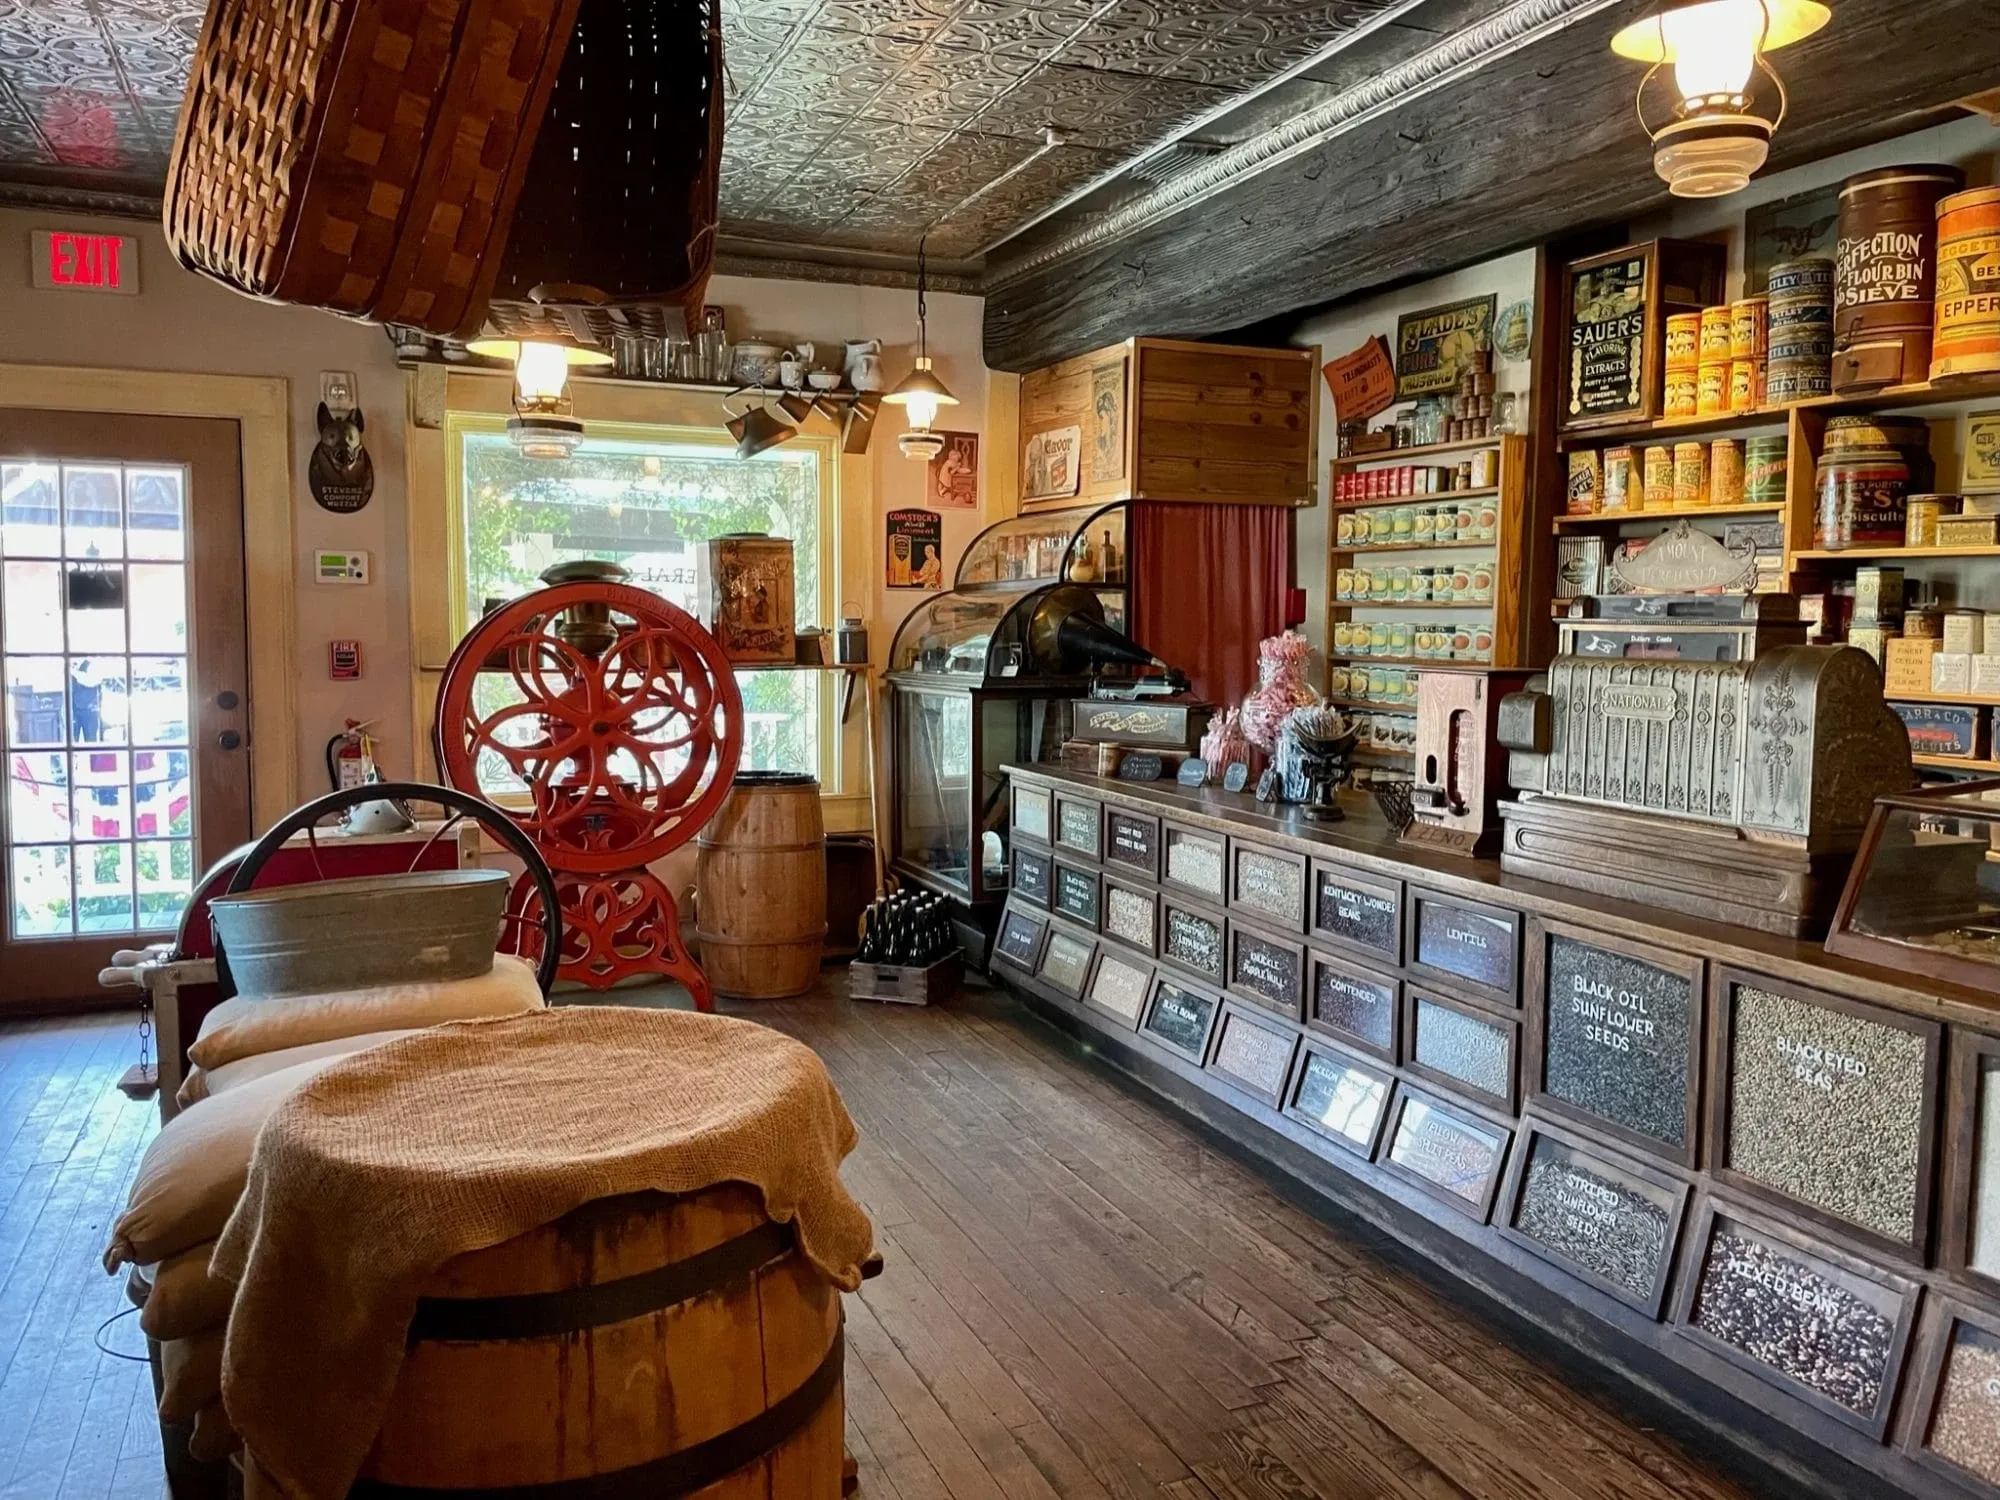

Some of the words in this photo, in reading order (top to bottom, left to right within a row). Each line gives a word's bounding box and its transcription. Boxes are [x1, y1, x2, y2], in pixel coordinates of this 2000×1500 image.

[50, 231, 123, 288] EXIT
[1837, 232, 1923, 283] ERFECTION
[1847, 260, 1894, 288] FLOUR
[1896, 258, 1925, 281] BIN
[1846, 281, 1919, 306] SIEVE
[1944, 297, 2000, 318] EPPER
[1572, 315, 1643, 346] SAUER'S
[1401, 352, 1438, 373] PURE
[1584, 342, 1628, 362] FLAVORING
[1585, 359, 1627, 377] EXTRACTS
[1584, 378, 1602, 388] PURITY
[1570, 479, 1594, 499] OATS
[889, 512, 938, 523] COMSTOCK'S
[896, 526, 935, 535] Liniment
[333, 640, 357, 651] FIRE
[1610, 693, 1667, 711] NATIONAL
[1903, 708, 1932, 721] ARR
[1418, 828, 1465, 845] ZENO
[1324, 885, 1361, 904] KENTUCKY
[1338, 905, 1361, 922] BEANS
[1446, 927, 1488, 949] LENTILS
[1243, 960, 1266, 979] PURPLE
[1250, 951, 1280, 970] KNUCKLE
[1329, 978, 1377, 1005] CONTENDER
[1574, 974, 1615, 1002] BLACK
[1619, 990, 1648, 1014] OIL
[1162, 998, 1179, 1014] BLACK
[1571, 997, 1655, 1039] SUNFLOWER
[1585, 1024, 1630, 1051] SEEDS
[1310, 1063, 1339, 1082] JACKSON
[1795, 1063, 1833, 1092] PEAS
[1426, 1119, 1461, 1143] YELLOW
[1417, 1134, 1443, 1158] SPLIT
[1442, 1150, 1467, 1169] PEAS
[1565, 1173, 1619, 1206] STRIPED
[1557, 1190, 1617, 1228] SUNFLOWER
[1566, 1214, 1600, 1239] SEEDS
[1728, 1251, 1787, 1293] MIXED
[1791, 1281, 1840, 1317] BEANS
